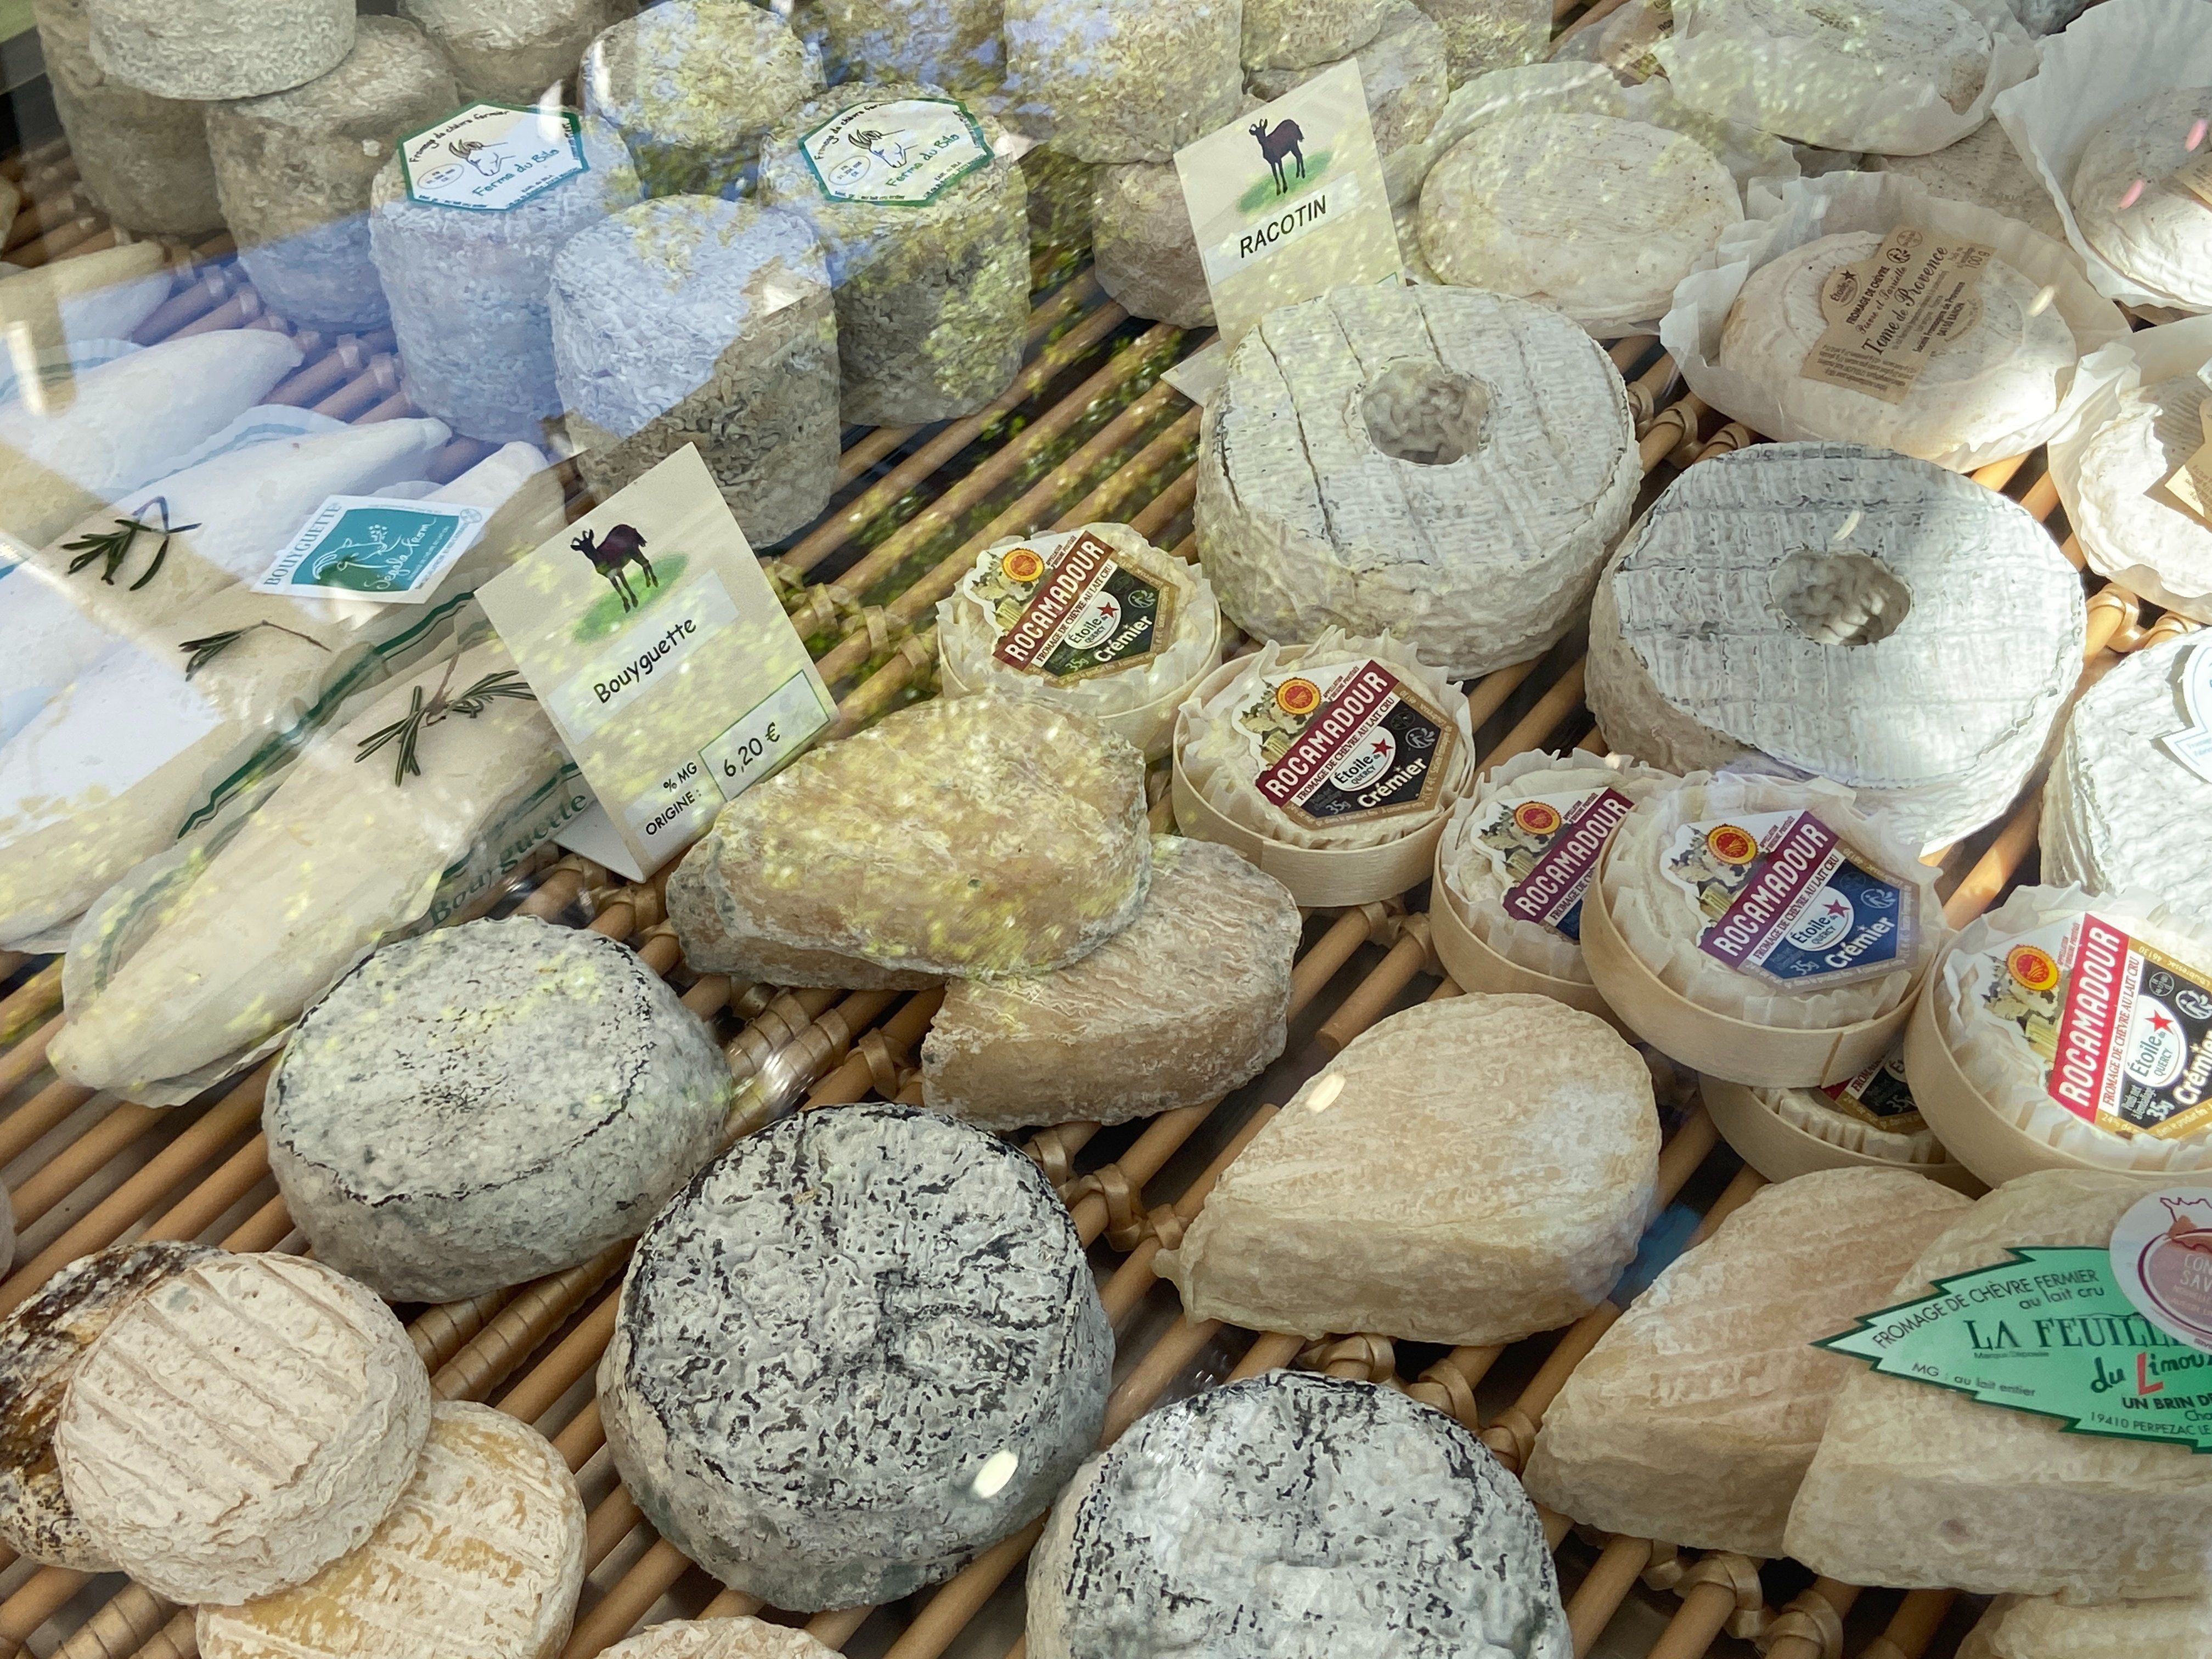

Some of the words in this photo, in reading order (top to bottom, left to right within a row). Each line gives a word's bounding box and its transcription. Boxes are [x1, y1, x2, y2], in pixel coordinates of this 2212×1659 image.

[514, 162, 533, 173] du
[919, 149, 937, 161] du
[1241, 195, 1326, 258] RACOTIN
[1894, 246, 1948, 307] Provence
[1846, 296, 1871, 325] FROMAGE
[1865, 287, 1876, 297] DE
[1892, 309, 1909, 321] de
[1861, 321, 1900, 356] Tome
[264, 503, 342, 586] BOUYGUETTE
[1005, 540, 1105, 662] ROCAMADOUR
[1037, 631, 1062, 662] FROMAGE
[1060, 623, 1068, 634] DE
[1084, 592, 1093, 603] AU
[1090, 577, 1104, 595] LAIT
[1100, 565, 1112, 579] CRU
[1068, 616, 1101, 644] Étoile
[1084, 625, 1105, 644] QUERCY
[1094, 615, 1152, 663] Crémier
[593, 619, 696, 703] Bouyguette
[1065, 658, 1090, 672] 35g
[724, 737, 763, 778] 6,20
[765, 722, 780, 742] €
[1265, 672, 1388, 798] ROCAMADOUR
[1297, 769, 1329, 800] FROMAGE
[1325, 760, 1337, 771] DE
[1357, 726, 1369, 740] AU
[1365, 712, 1382, 728] LAIT
[1380, 697, 1395, 713] CRU
[663, 778, 677, 793] %
[678, 761, 698, 784] MG
[1335, 756, 1373, 783] Étoile
[1352, 765, 1376, 785] QUERCY
[1358, 757, 1427, 809] Crémier
[646, 791, 696, 836] ORIGINE
[1325, 799, 1352, 815] 35g
[1515, 798, 1628, 917] ROCAMADOUR
[1550, 890, 1580, 921] FROMAGE
[1576, 880, 1588, 891] DE
[1713, 823, 1829, 957] ROCAMADOUR
[1753, 929, 1782, 960] FROMAGE
[1777, 919, 1789, 931] DE
[1805, 881, 1817, 897] AU
[1814, 868, 1828, 887] LAIT
[1823, 854, 1839, 871] CRU
[1790, 917, 1831, 944] Étoile
[1811, 926, 1836, 945] QUERCY
[1824, 916, 1896, 969] Crémier
[1790, 960, 1820, 975] 35g
[2127, 956, 2140, 977] CRU
[2138, 946, 2163, 962] 46130
[2124, 975, 2137, 999] LAIT
[2168, 960, 2211, 987] Loubressac
[2059, 927, 2120, 1107] ROCAMADOUR
[2121, 996, 2132, 1012] AU
[2114, 1011, 2130, 1047] CHÈVRE
[2112, 1046, 2123, 1063] DE
[2127, 1036, 2162, 1077] Étoile
[2154, 1048, 2172, 1076] QUERCY
[2103, 1063, 2120, 1107] FROMAGE
[2146, 1099, 2175, 1121] 35g
[1872, 1303, 1948, 1349] FROMAGE
[1945, 1294, 1970, 1311] DE
[1969, 1278, 2034, 1303] CHÈVRE
[2034, 1269, 2100, 1288] FERMIER
[2019, 1297, 2041, 1310] au
[2044, 1288, 2073, 1303] lait
[2078, 1287, 2104, 1298] cru
[1963, 1319, 2022, 1351] LA
[2033, 1317, 2187, 1347] FEUILL
[1912, 1362, 1939, 1376] MG
[1954, 1376, 1972, 1385] au
[1977, 1377, 1996, 1390] lait
[2000, 1385, 2036, 1396] entier
[2091, 1357, 2126, 1393] du
[2122, 1397, 2148, 1409] UN
[2153, 1397, 2195, 1409] BRIN
[2091, 1412, 2129, 1429] 19410
[2134, 1420, 2196, 1435] PERPEZAC
[2199, 1425, 2211, 1435] LE
